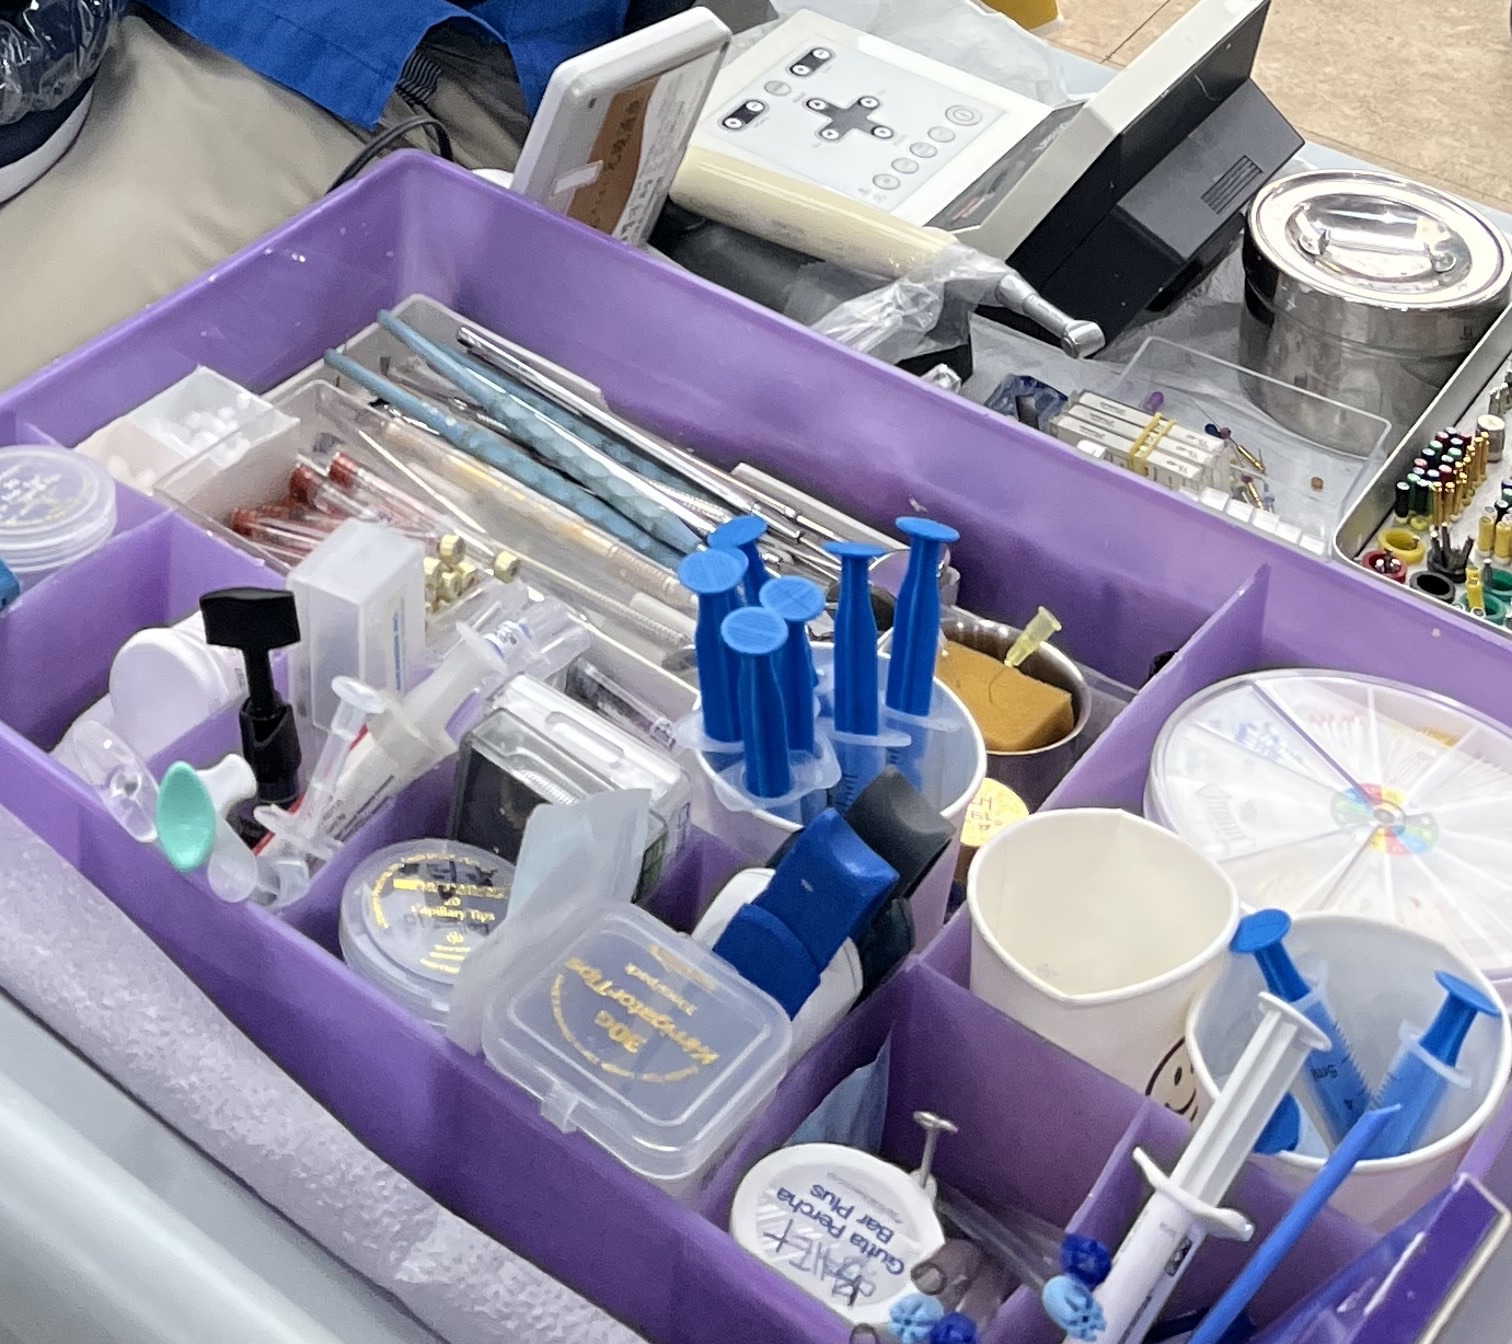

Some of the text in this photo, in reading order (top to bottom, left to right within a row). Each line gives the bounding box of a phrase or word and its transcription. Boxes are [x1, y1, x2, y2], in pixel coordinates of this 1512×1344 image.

[469, 909, 496, 923] Tips
[776, 1186, 847, 1240] Percha
[809, 1184, 855, 1220] Plus
[856, 1214, 895, 1244] Bar
[849, 1232, 905, 1276] Gutta
